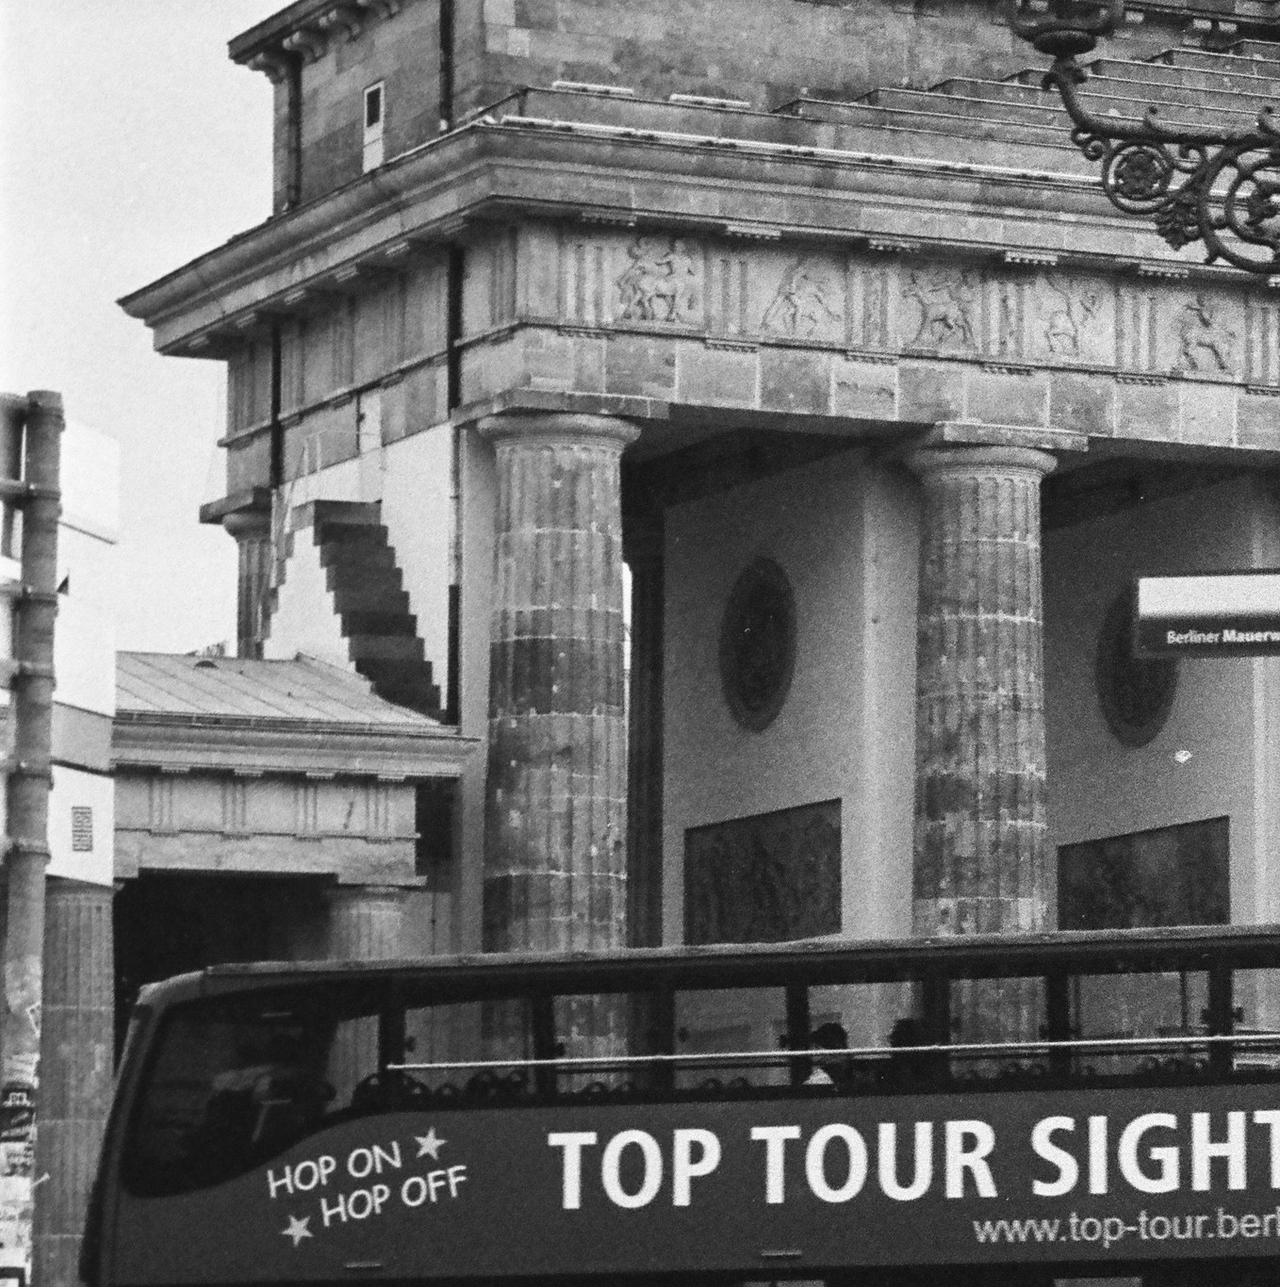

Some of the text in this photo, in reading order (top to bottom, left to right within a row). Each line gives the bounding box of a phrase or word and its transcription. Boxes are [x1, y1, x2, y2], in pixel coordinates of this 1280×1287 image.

[1166, 629, 1220, 645] Berliner
[267, 1140, 402, 1199] HOP ON
[547, 1128, 722, 1210] TOP
[750, 1119, 998, 1205] TOUR
[320, 1165, 467, 1227] HOP OFF
